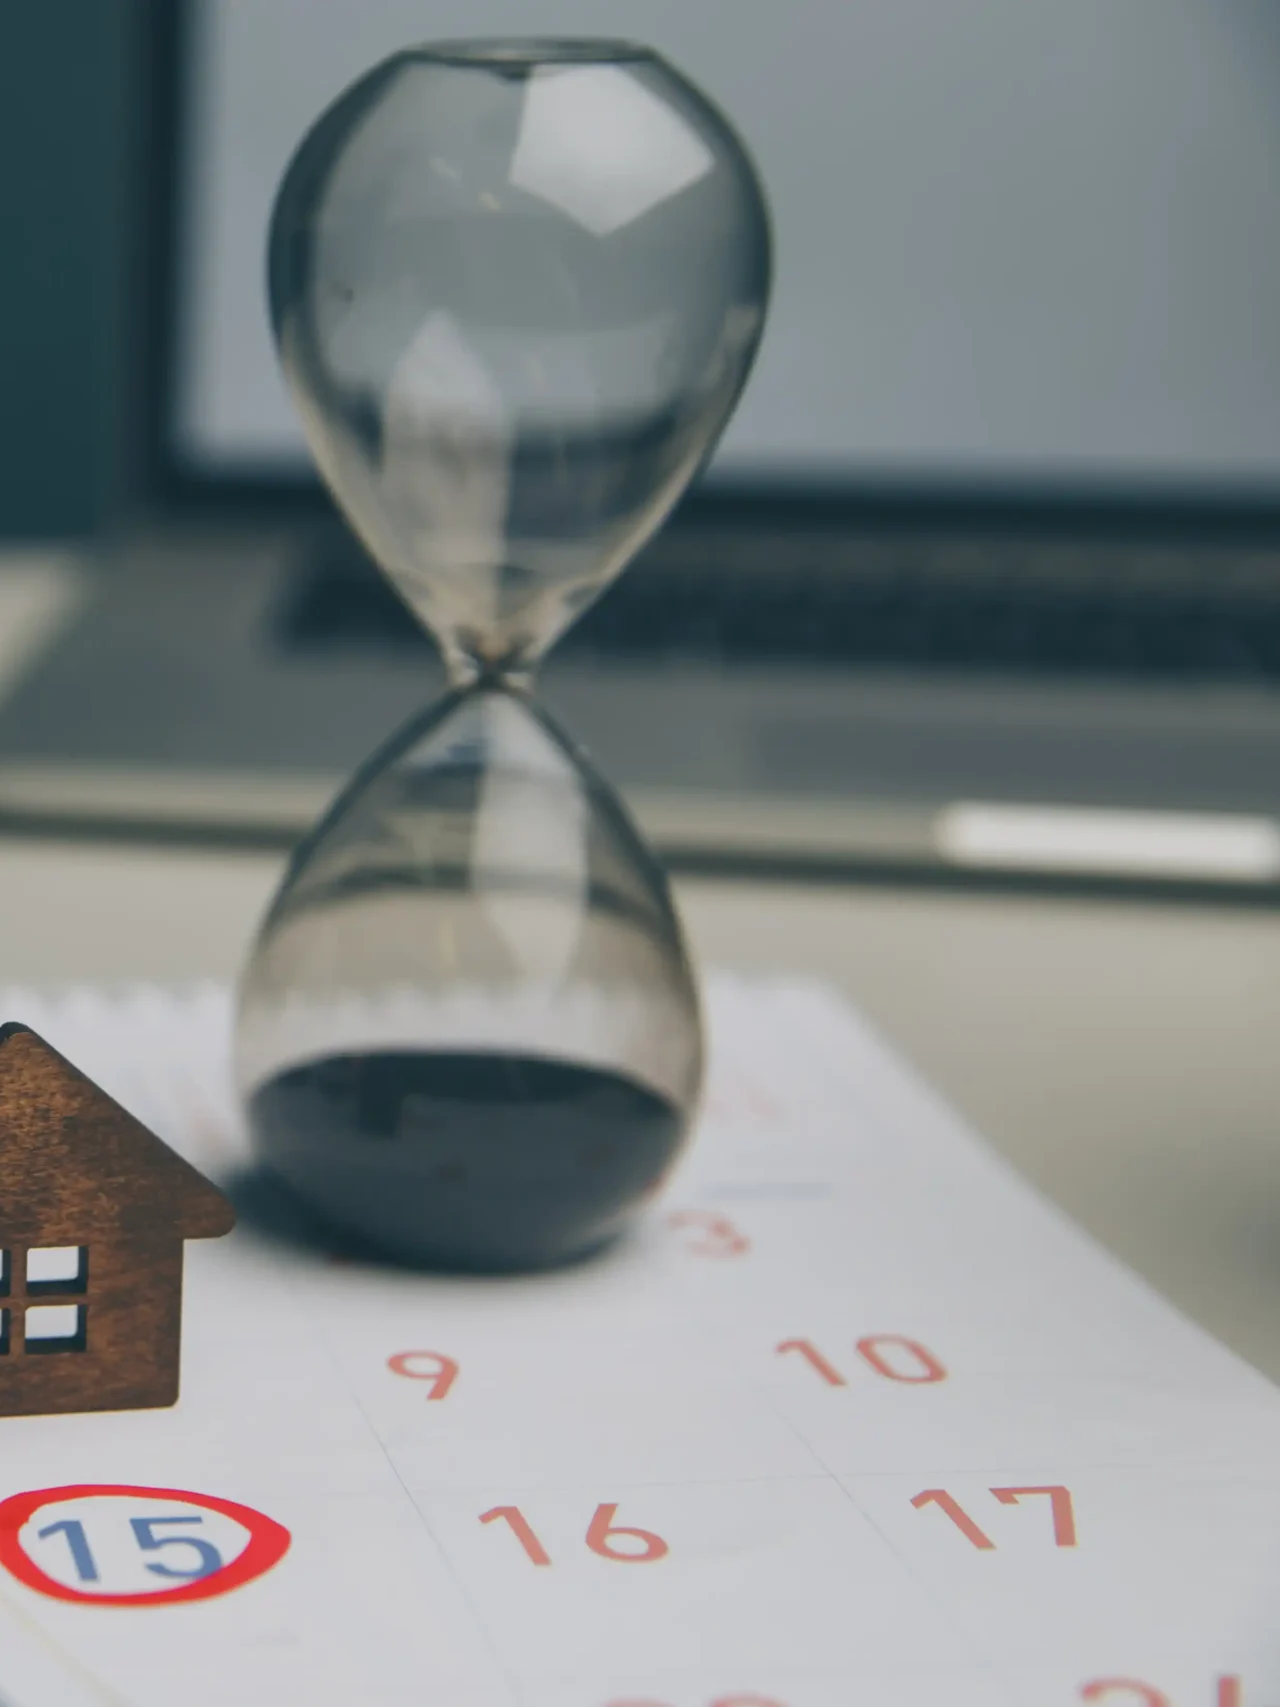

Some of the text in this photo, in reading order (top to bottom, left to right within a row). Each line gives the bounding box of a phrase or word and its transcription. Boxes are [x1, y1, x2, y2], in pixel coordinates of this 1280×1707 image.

[387, 1350, 459, 1400] 9
[775, 1334, 949, 1388] 10
[37, 1516, 224, 1582] 15
[478, 1503, 669, 1567] 16
[910, 1485, 1077, 1551] 17
